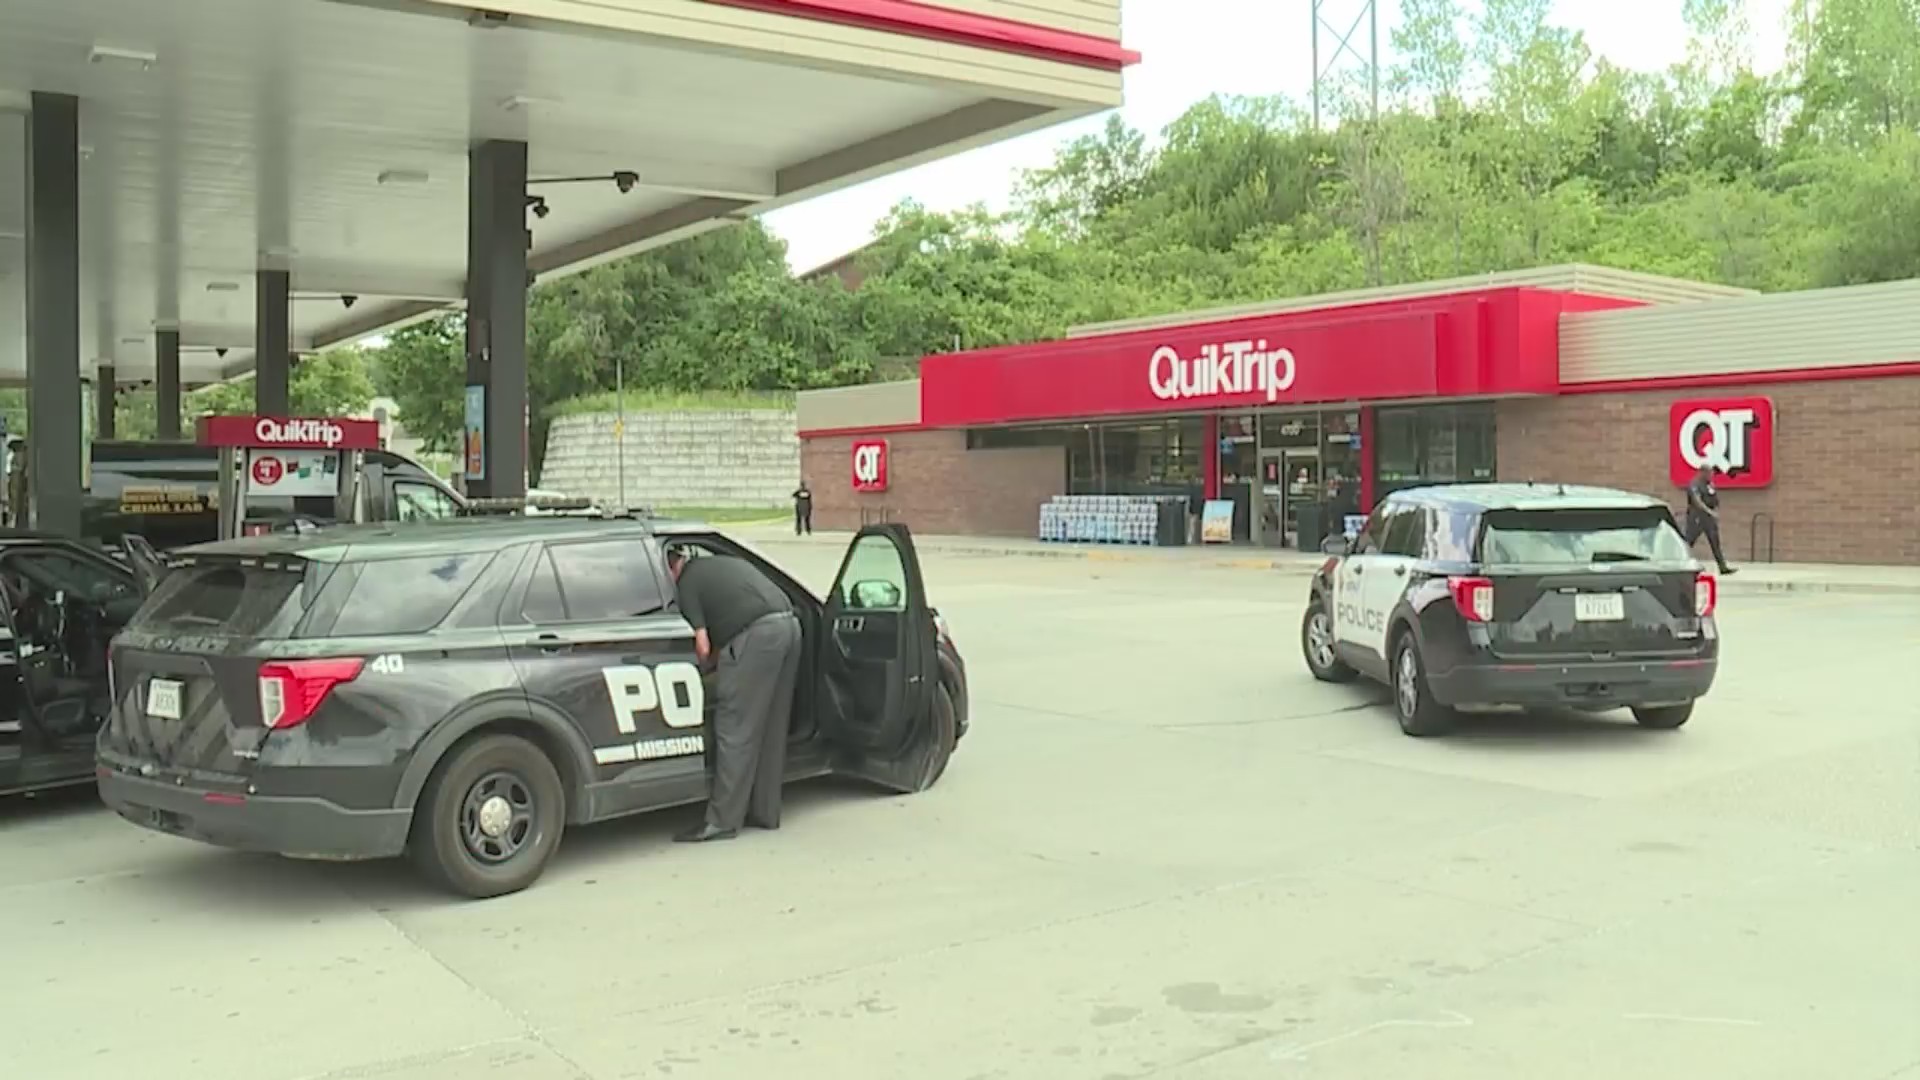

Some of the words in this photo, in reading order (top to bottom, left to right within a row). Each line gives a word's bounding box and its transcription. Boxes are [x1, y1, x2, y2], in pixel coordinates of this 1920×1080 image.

[1149, 339, 1296, 402] QuikTrip
[256, 418, 343, 448] QuikTrip
[1680, 408, 1754, 474] QT
[855, 445, 881, 484] QT
[120, 503, 171, 513] CRIME
[173, 503, 203, 513] LAB
[1338, 601, 1385, 633] POLICE
[371, 654, 404, 674] 40
[635, 735, 704, 760] MISSION
